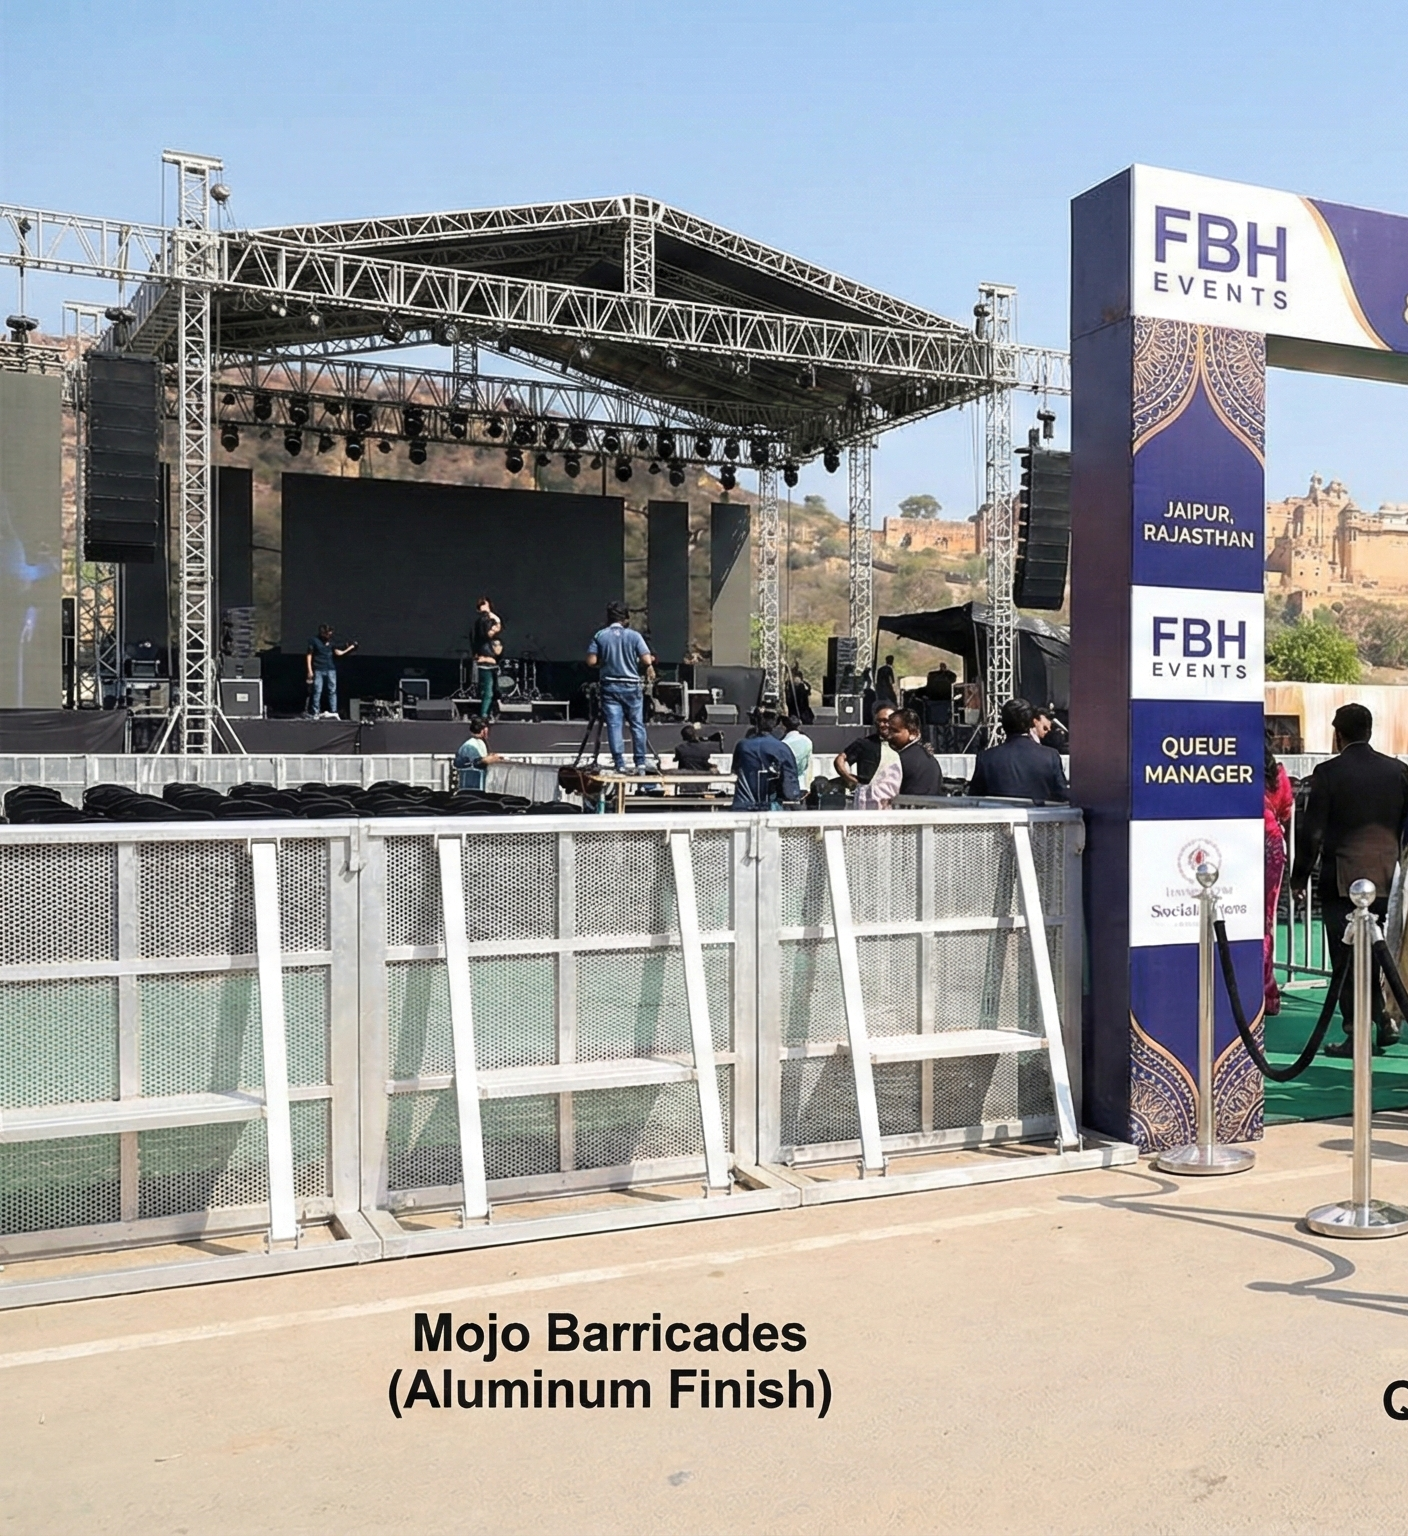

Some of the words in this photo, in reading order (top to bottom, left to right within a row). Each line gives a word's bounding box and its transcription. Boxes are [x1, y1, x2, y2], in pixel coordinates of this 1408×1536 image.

[1155, 205, 1287, 283] FBH
[1154, 271, 1288, 310] EVENTS
[1164, 501, 1234, 526] JAIPUR,
[1144, 523, 1255, 549] RAJASTHAN
[1152, 616, 1247, 661] FBH
[1152, 662, 1247, 680] EVENTS
[1162, 737, 1237, 758] QUEUE
[1145, 765, 1253, 784] MANAGER
